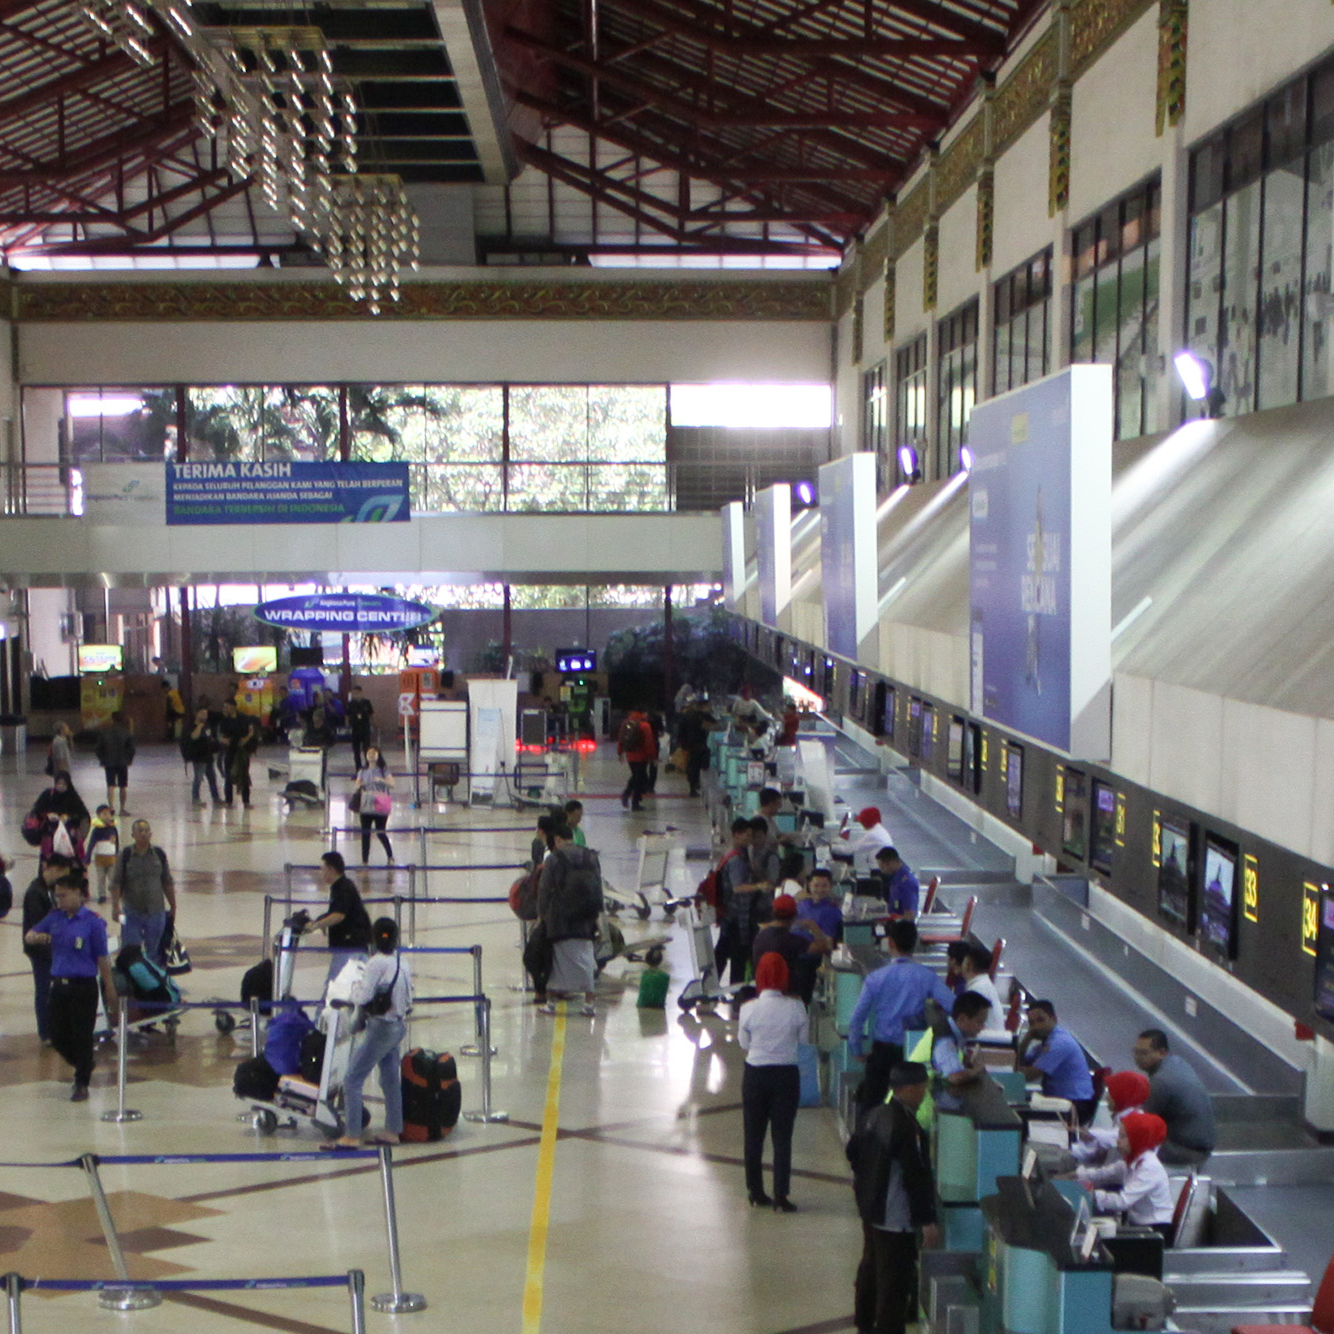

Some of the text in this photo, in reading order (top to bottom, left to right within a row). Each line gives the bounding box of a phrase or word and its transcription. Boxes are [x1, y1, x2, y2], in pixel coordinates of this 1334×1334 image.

[173, 463, 292, 479] TERIMA KASIH
[173, 479, 403, 491] KEPADA SELURUH PELANGGAN KAMI YANG TELAH BERPERAN
[173, 491, 333, 501] MENJADIKAN BANDARA JUANDA SEBAGAI
[264, 610, 355, 622] WRAPPING
[1244, 867, 1258, 908] 33
[1304, 897, 1317, 941] 34
